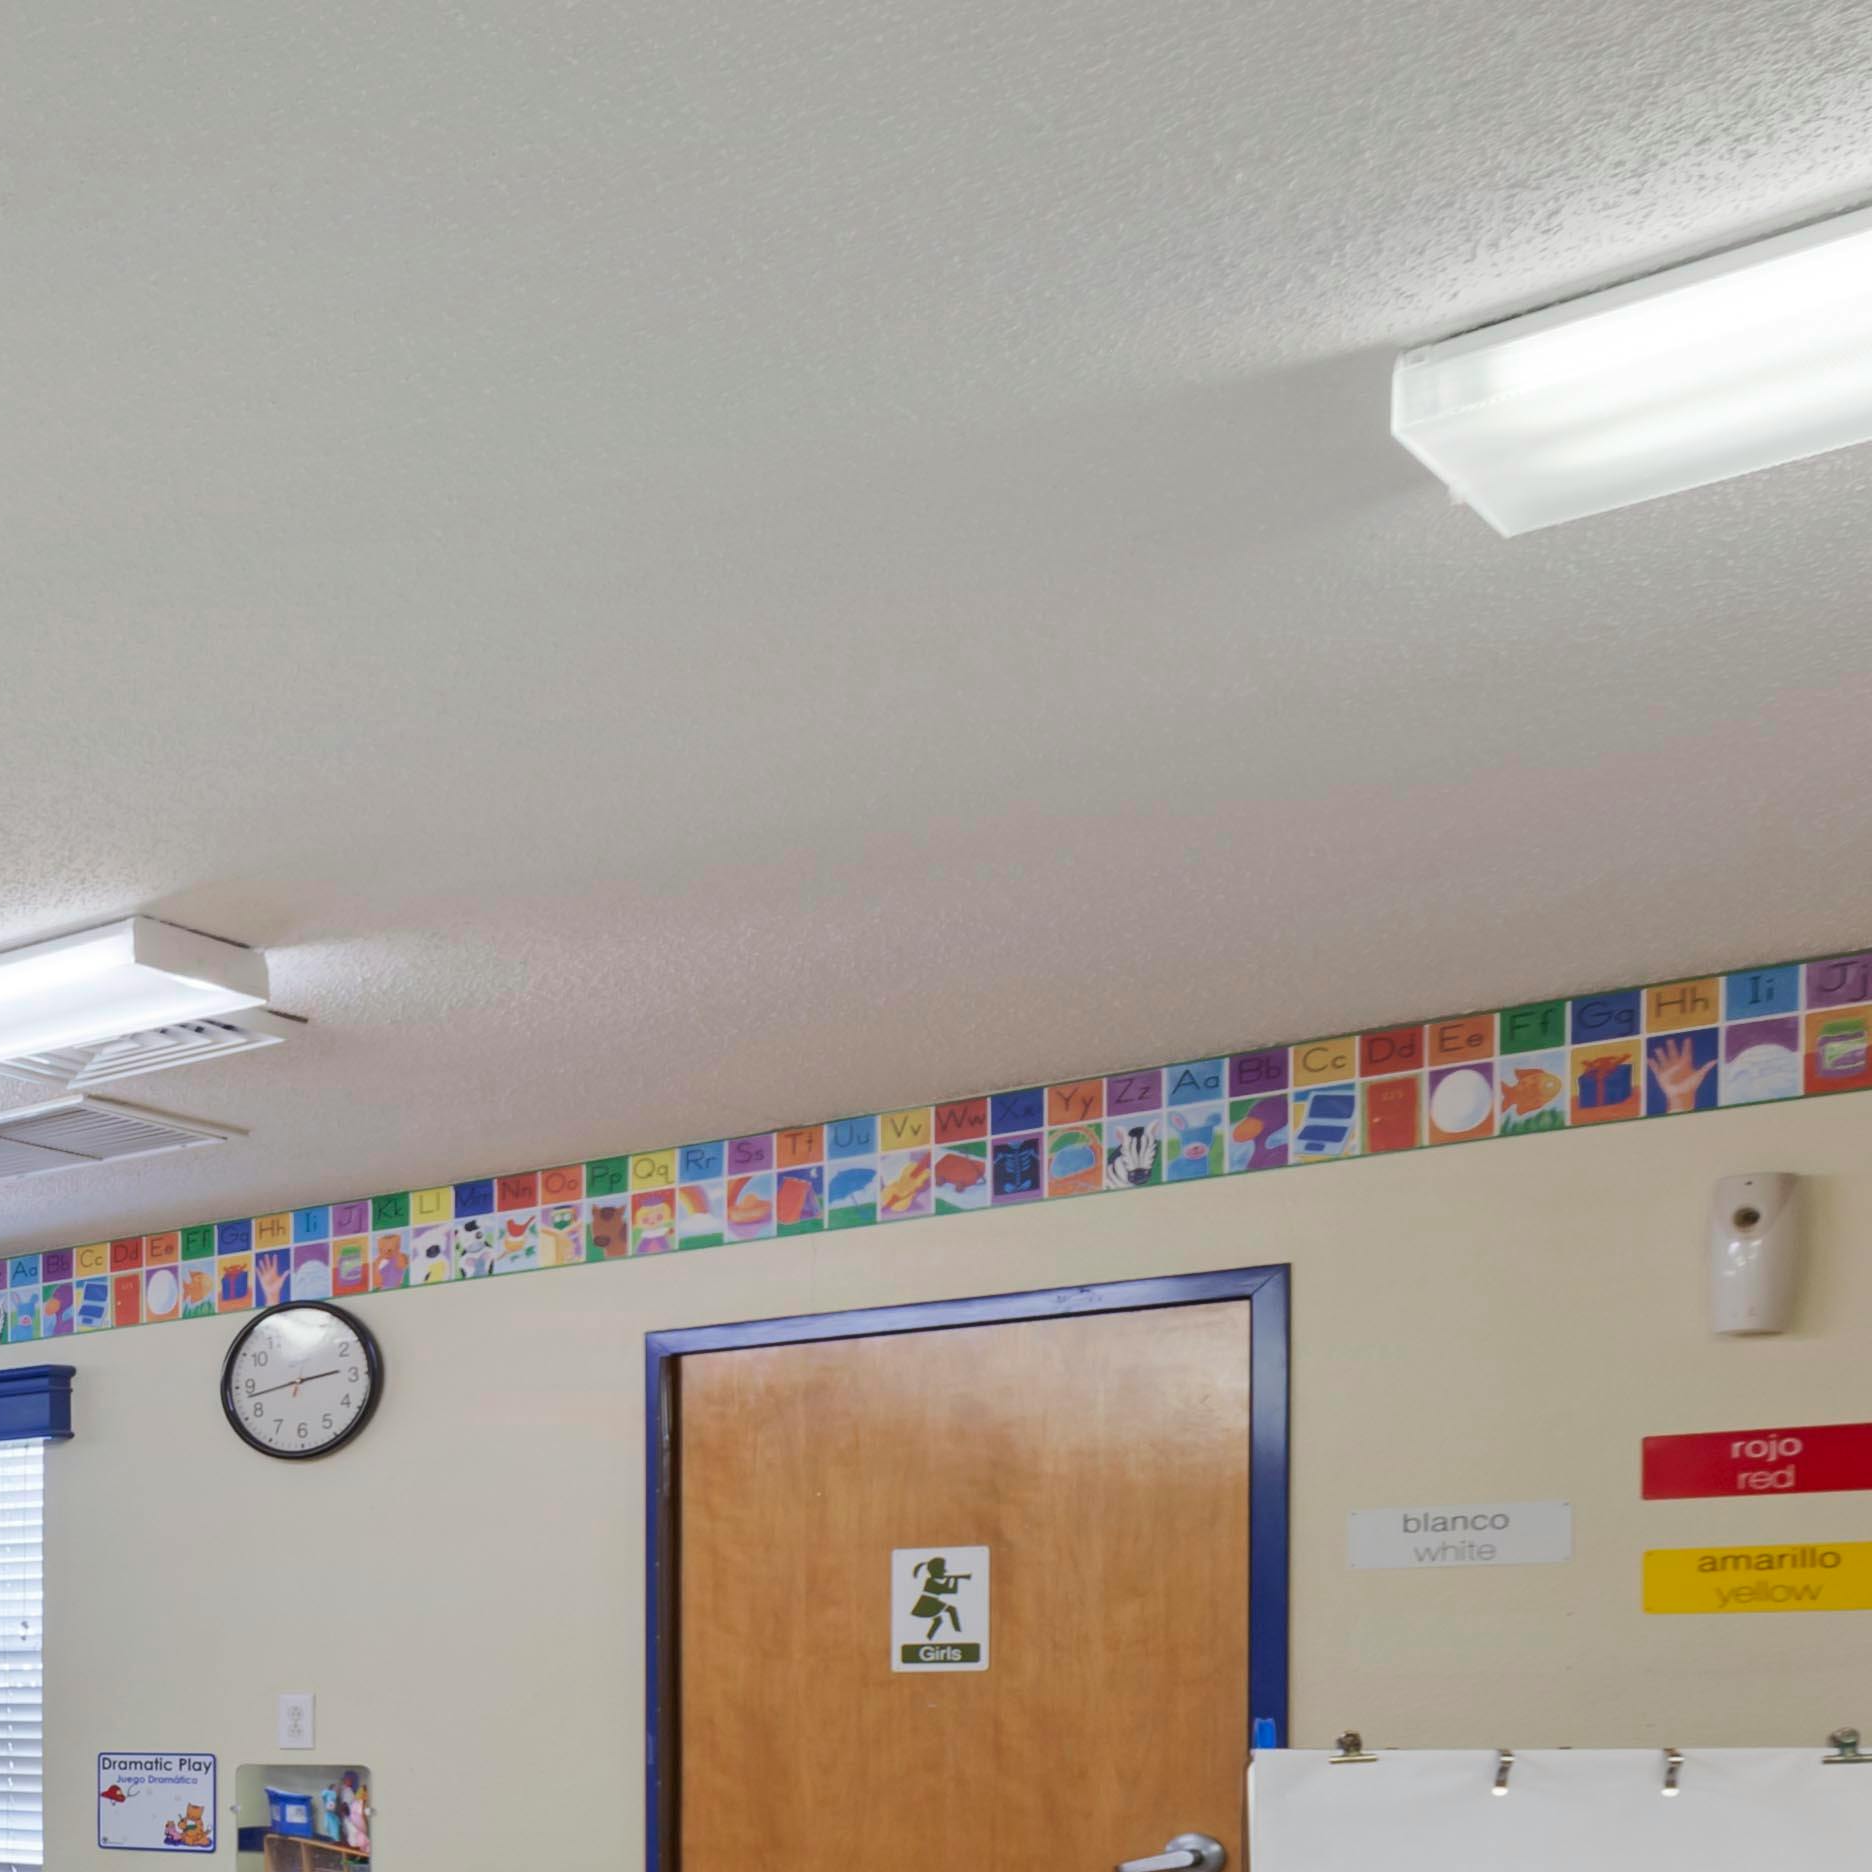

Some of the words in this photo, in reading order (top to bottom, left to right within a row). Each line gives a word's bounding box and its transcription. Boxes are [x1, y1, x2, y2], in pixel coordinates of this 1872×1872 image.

[339, 1342, 349, 1357] 2
[251, 1351, 268, 1367] 10
[348, 1367, 359, 1382] 3
[245, 1379, 256, 1394] 9
[340, 1394, 351, 1407] 4
[253, 1403, 263, 1417] 8
[273, 1419, 283, 1434] 7
[322, 1414, 333, 1429] 5
[297, 1423, 308, 1438] 6
[1731, 1435, 1802, 1461] rojo
[1737, 1466, 1796, 1489] red
[1403, 1512, 1510, 1534] blanco
[1413, 1540, 1497, 1563] white
[1697, 1546, 1841, 1573] amarillo
[1714, 1580, 1823, 1608] yellow
[919, 1645, 962, 1662] Girls
[102, 1757, 173, 1772] Dramatic
[179, 1757, 213, 1775] Play
[117, 1775, 145, 1785] Juego
